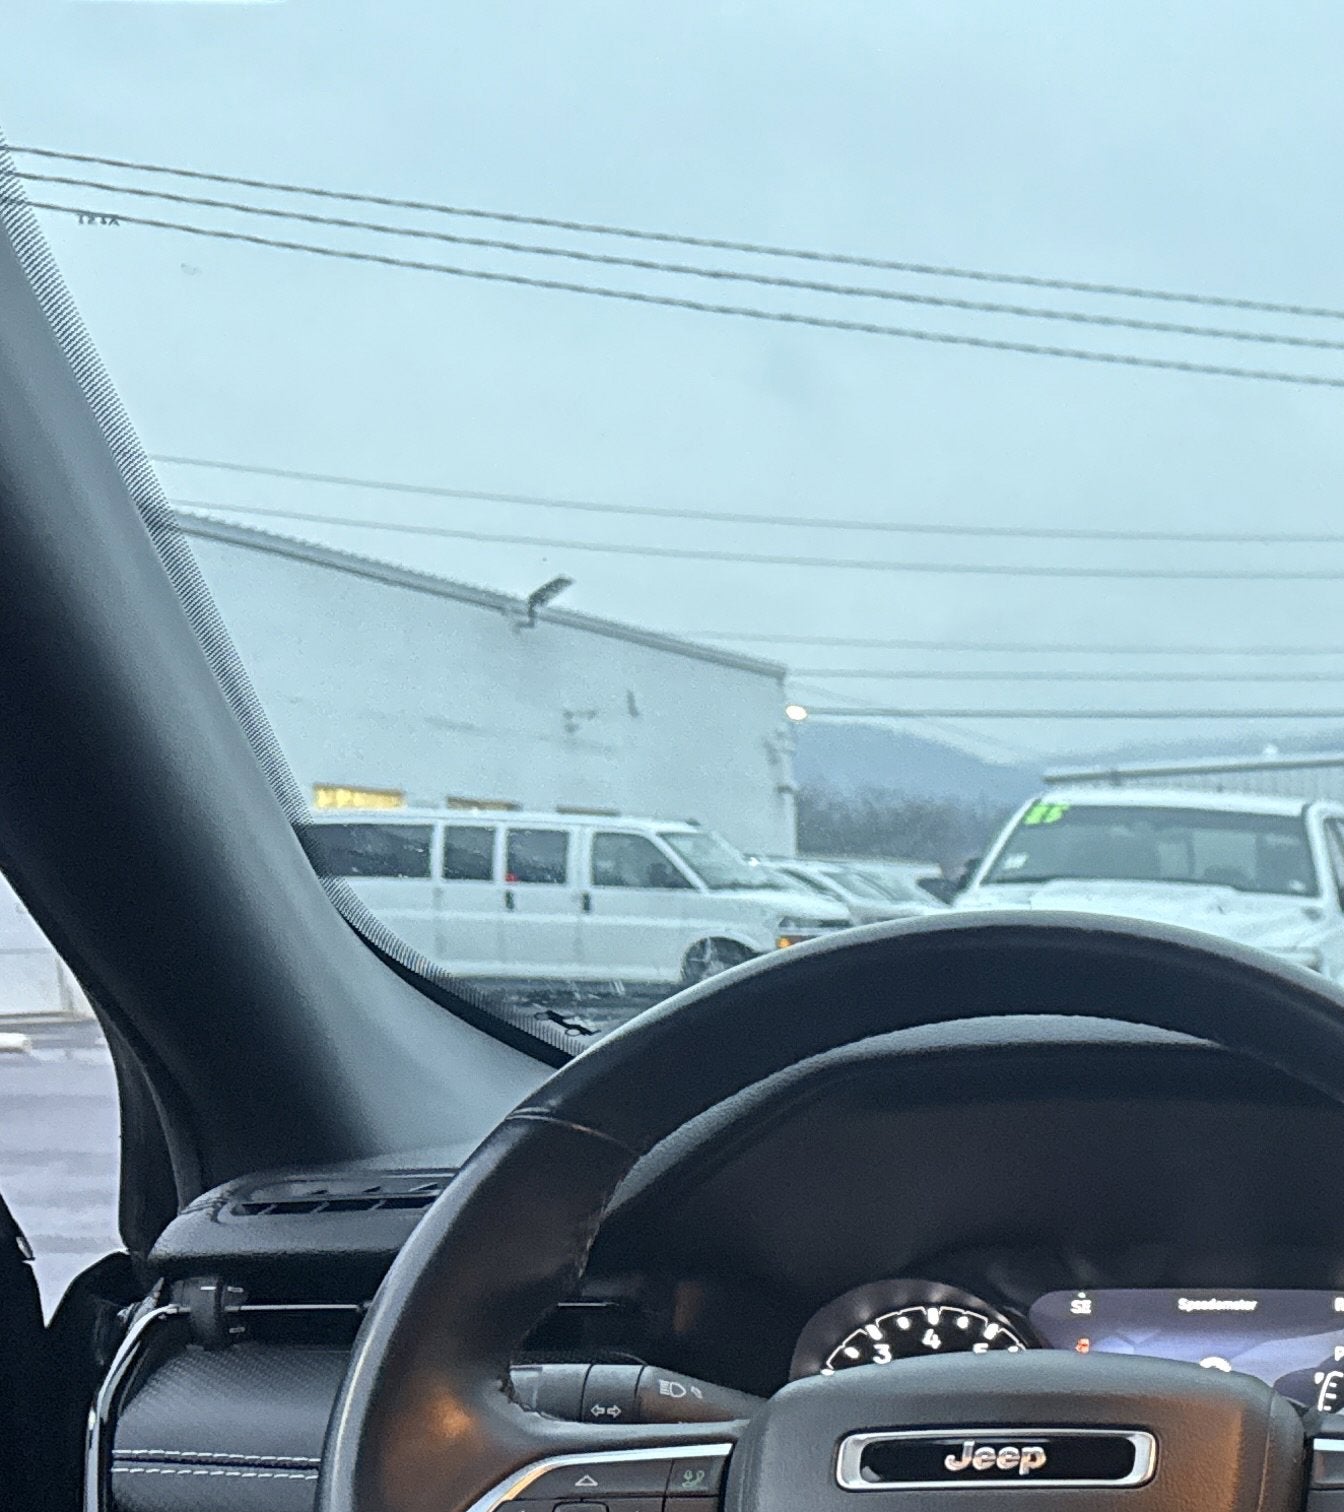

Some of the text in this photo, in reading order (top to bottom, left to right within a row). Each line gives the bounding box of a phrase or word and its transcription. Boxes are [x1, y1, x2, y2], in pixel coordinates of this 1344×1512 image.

[1177, 1296, 1259, 1312] Speedometer
[922, 1328, 942, 1349] 4
[872, 1343, 892, 1364] 3
[944, 1440, 1047, 1476] Jeep
